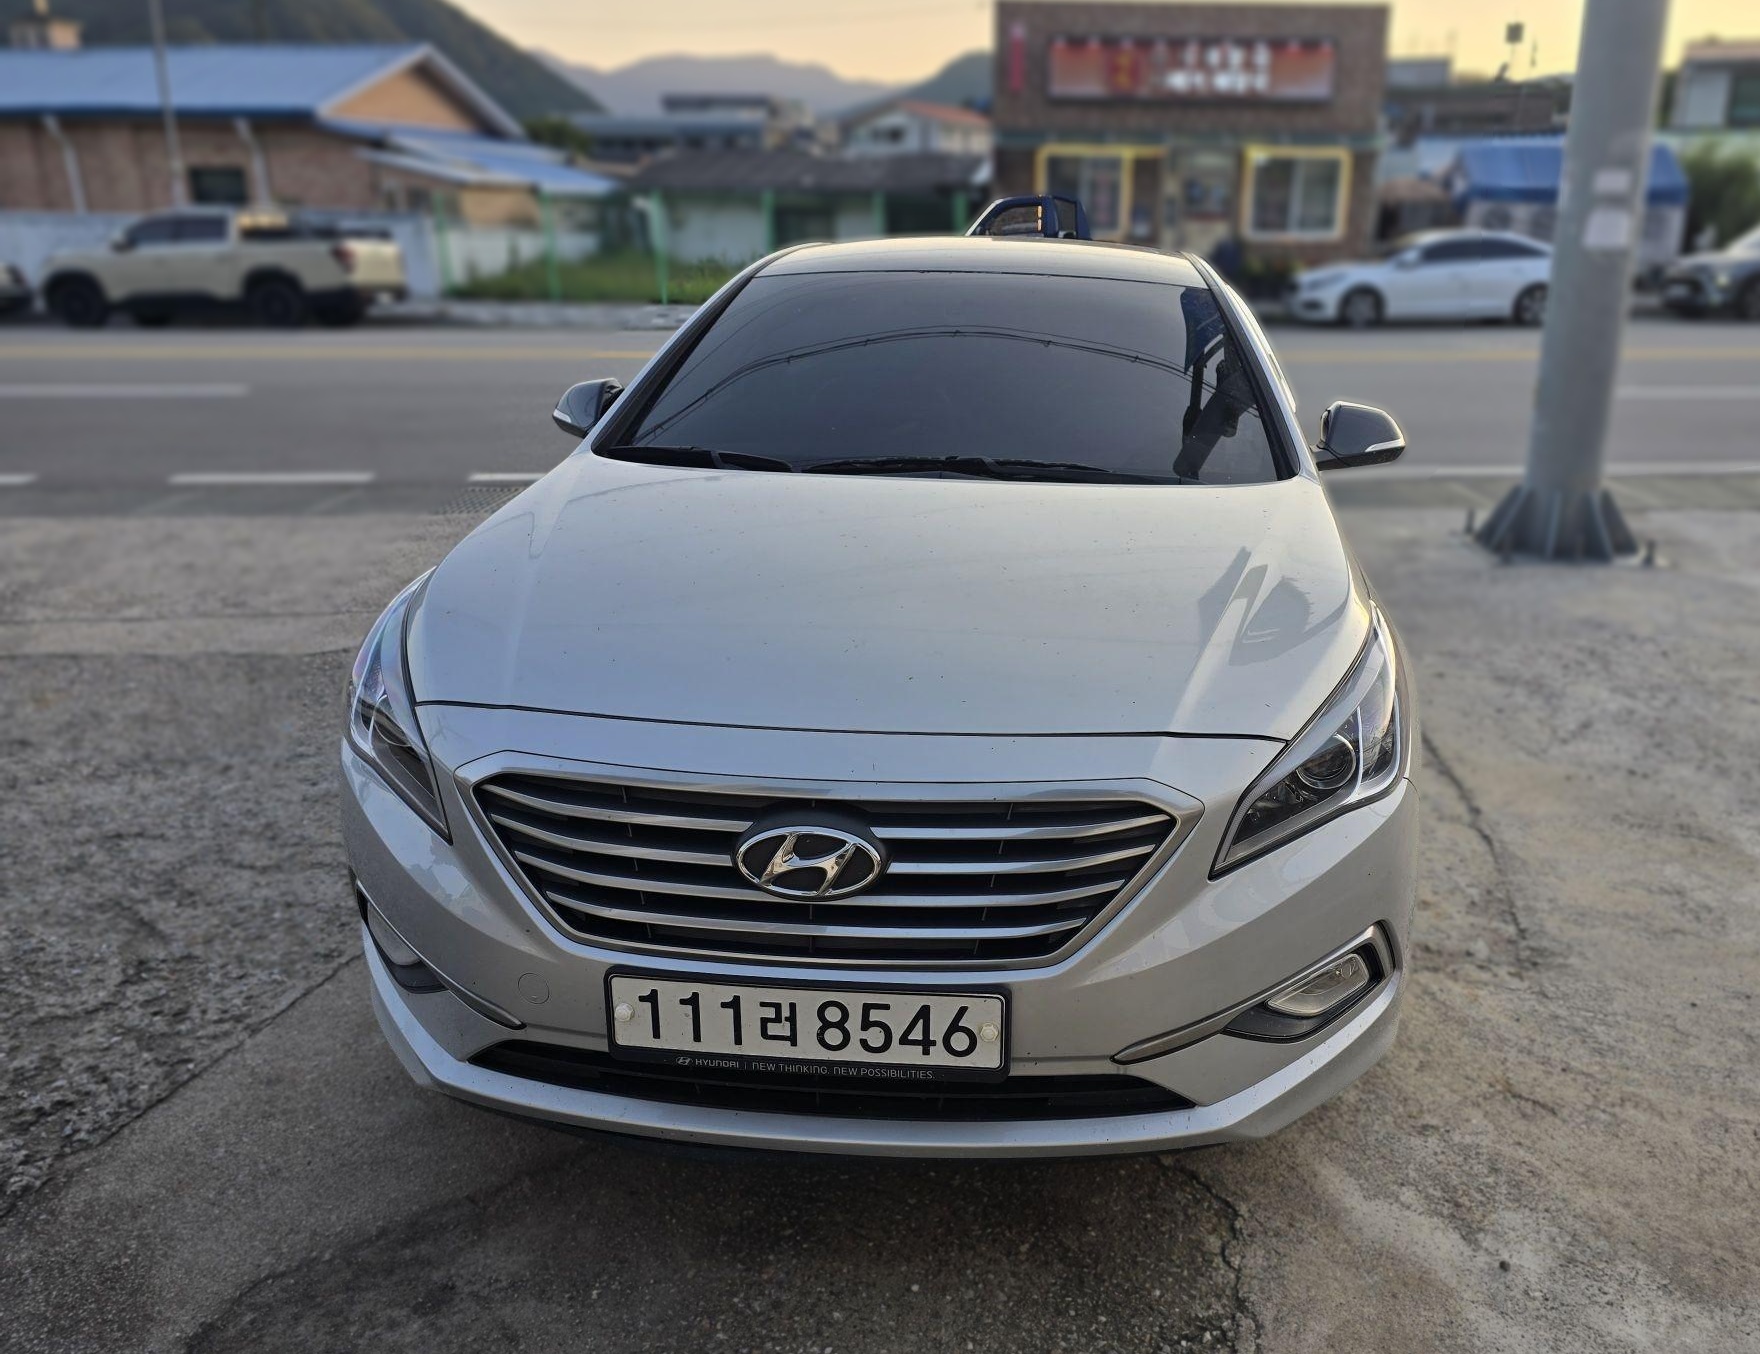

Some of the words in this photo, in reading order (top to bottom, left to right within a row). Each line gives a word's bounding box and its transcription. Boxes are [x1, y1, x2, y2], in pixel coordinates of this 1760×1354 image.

[694, 1058, 740, 1069] HYUNDAI
[752, 1062, 776, 1071] NEW
[779, 1063, 830, 1075] THINKING.
[833, 1066, 858, 1076] NEW
[860, 1068, 936, 1079] POSSIBILITIES.
